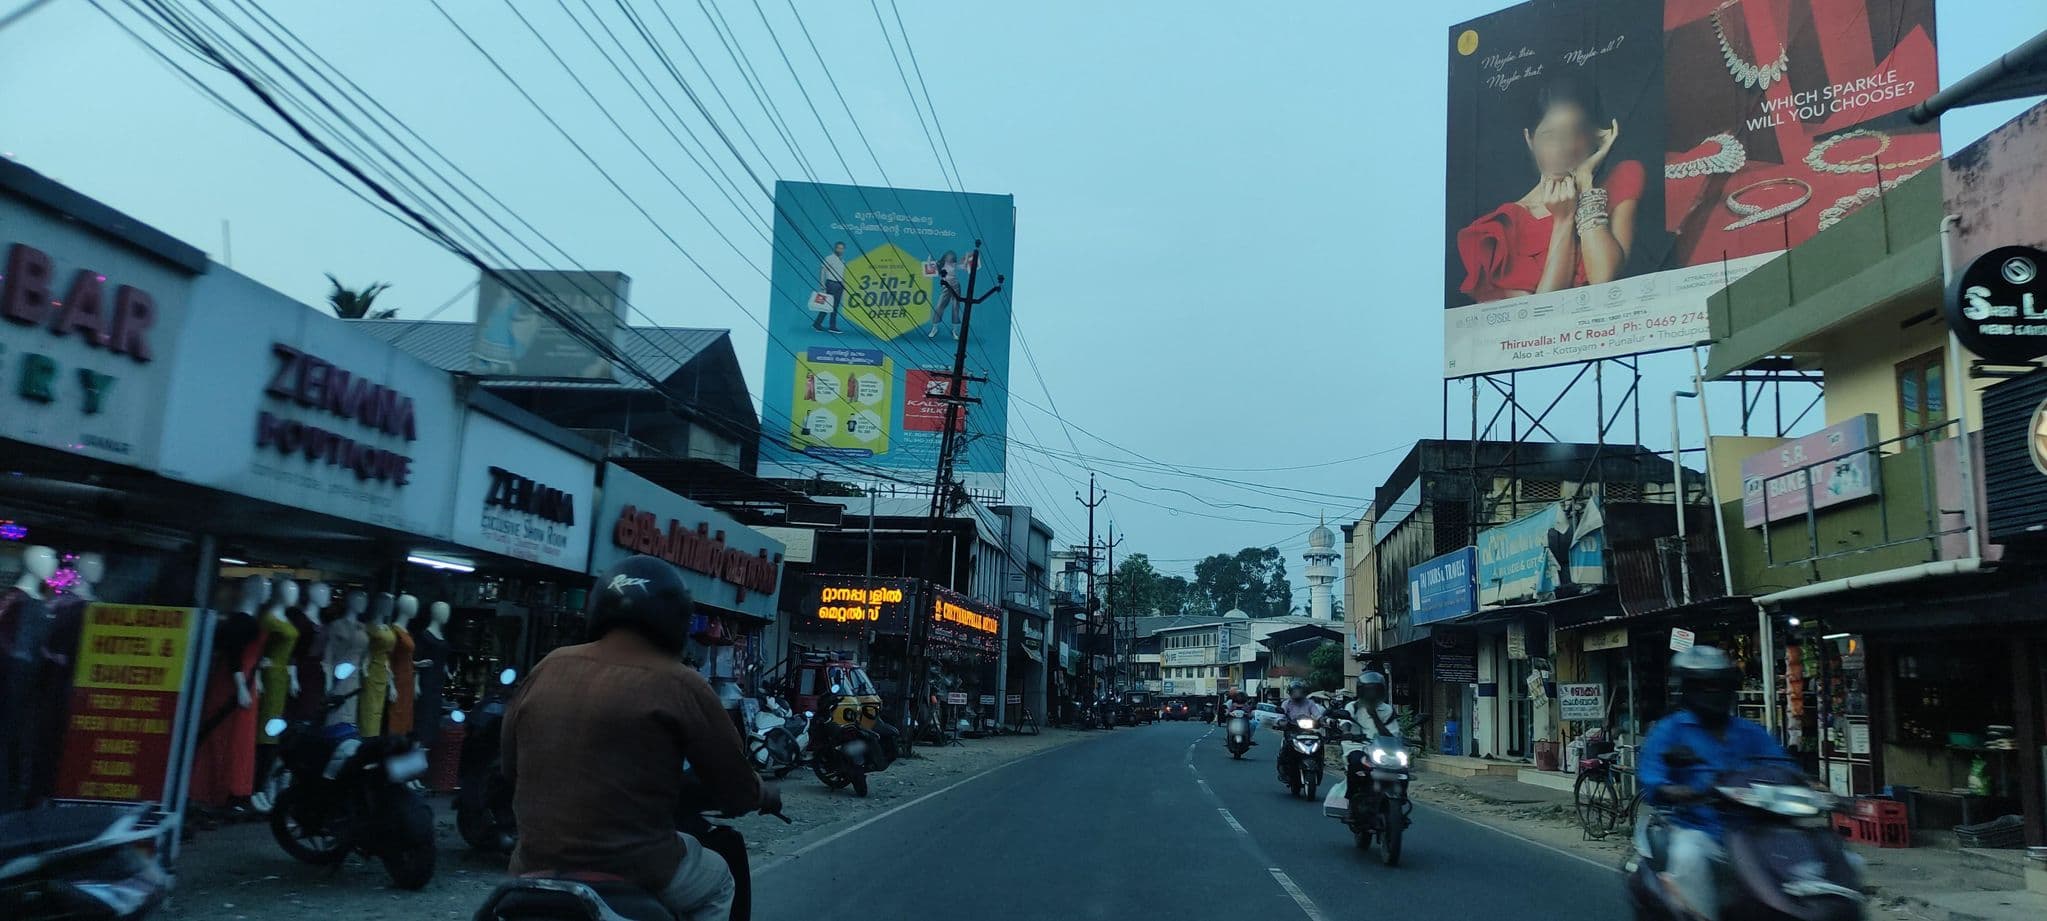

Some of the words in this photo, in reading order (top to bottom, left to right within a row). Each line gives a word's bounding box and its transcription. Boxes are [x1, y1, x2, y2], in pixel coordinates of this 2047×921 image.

[1481, 50, 1517, 71] Maybe
[1564, 47, 1599, 67] Maybe
[1486, 70, 1522, 92] Maybe
[1760, 89, 1818, 114] WHICH
[1822, 69, 1898, 100] SPARKLE
[1746, 113, 1785, 132] WILL
[1788, 102, 1825, 122] YOU
[1829, 81, 1916, 112] CHOOSE?
[847, 289, 928, 309] COMBO
[868, 308, 906, 319] OFFER
[1500, 335, 1557, 352] Thiruvalla:
[1559, 332, 1571, 343] M
[1574, 330, 1583, 341] C
[1586, 325, 1616, 339] Road
[1622, 321, 1642, 334] Ph:
[1646, 315, 1677, 329] 0469
[1512, 351, 1532, 361] Also
[1534, 348, 1544, 358] at
[1608, 334, 1646, 348] Punalur
